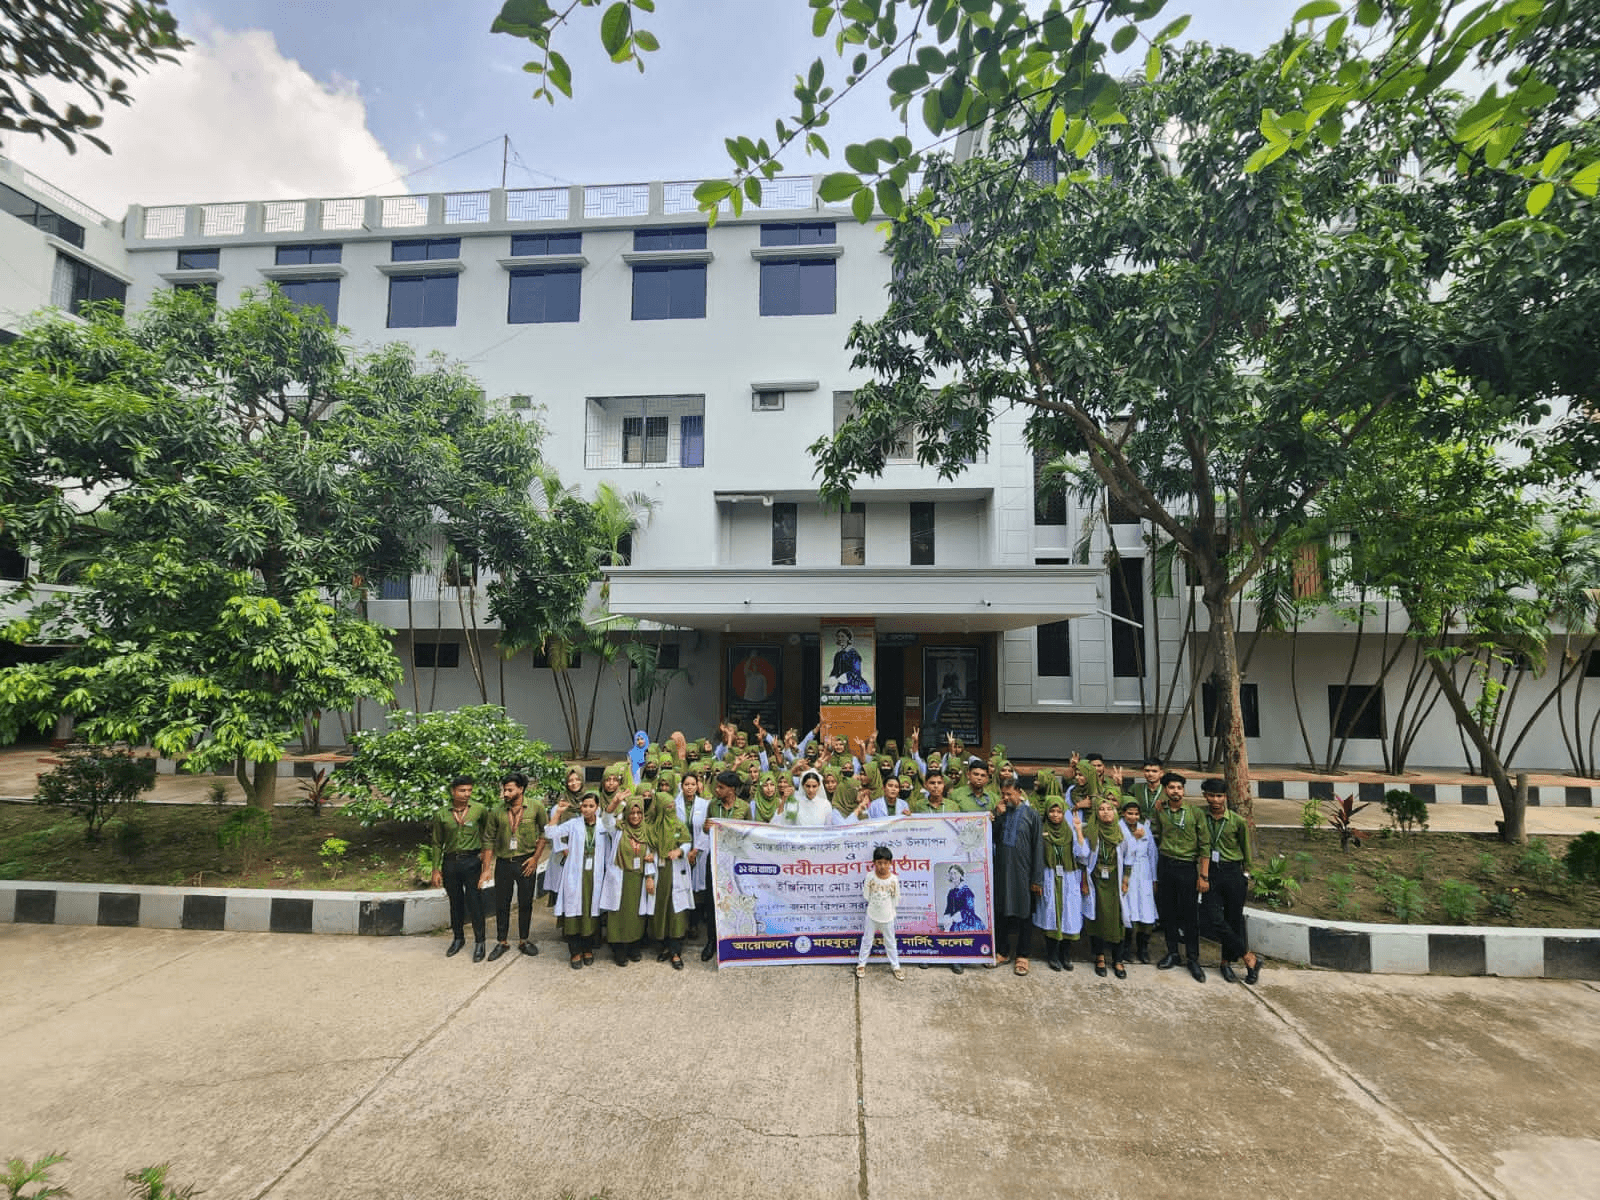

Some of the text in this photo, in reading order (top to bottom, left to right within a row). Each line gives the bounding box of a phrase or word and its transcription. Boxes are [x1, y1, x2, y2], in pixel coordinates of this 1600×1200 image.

[845, 852, 856, 860] ও
[782, 859, 862, 876] নবীনবরণ
[935, 937, 975, 948] কলেজ
